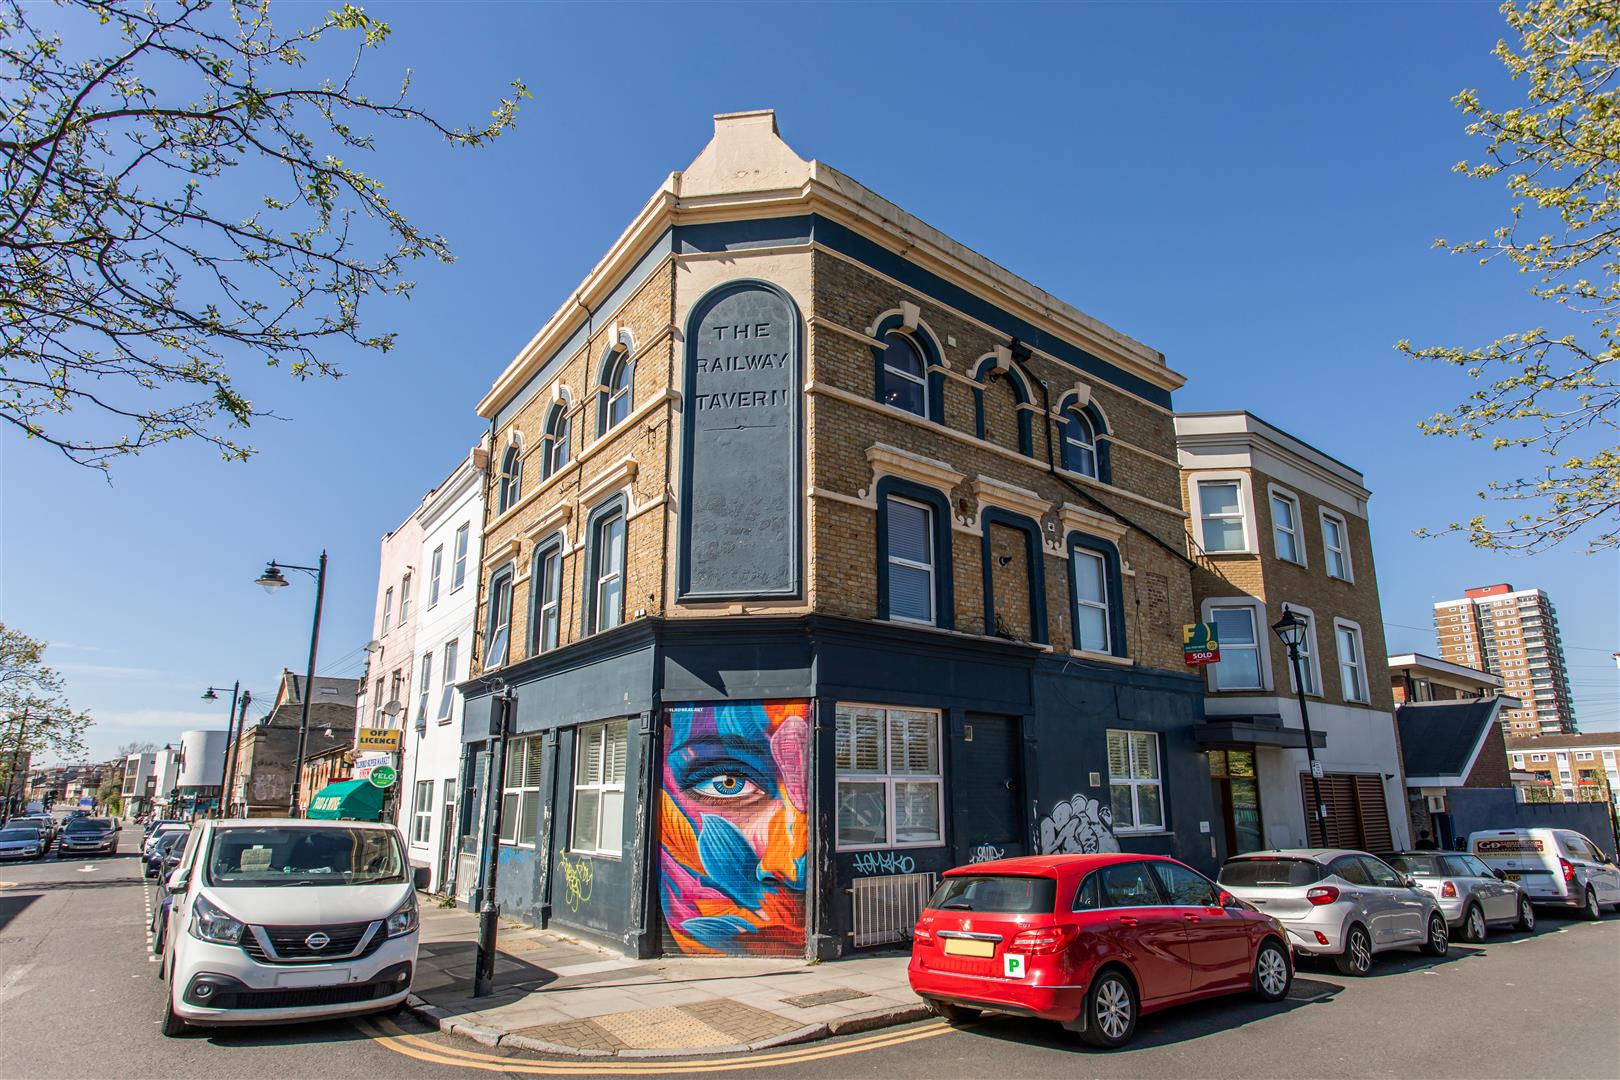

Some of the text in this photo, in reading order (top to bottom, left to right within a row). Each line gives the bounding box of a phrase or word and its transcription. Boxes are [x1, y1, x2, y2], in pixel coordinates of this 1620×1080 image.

[713, 323, 770, 341] THE
[697, 353, 789, 374] RAILWAY
[696, 389, 788, 411] TAVERN
[1192, 652, 1212, 660] SOLD
[373, 772, 394, 780] VELO
[1008, 958, 1020, 972] P
